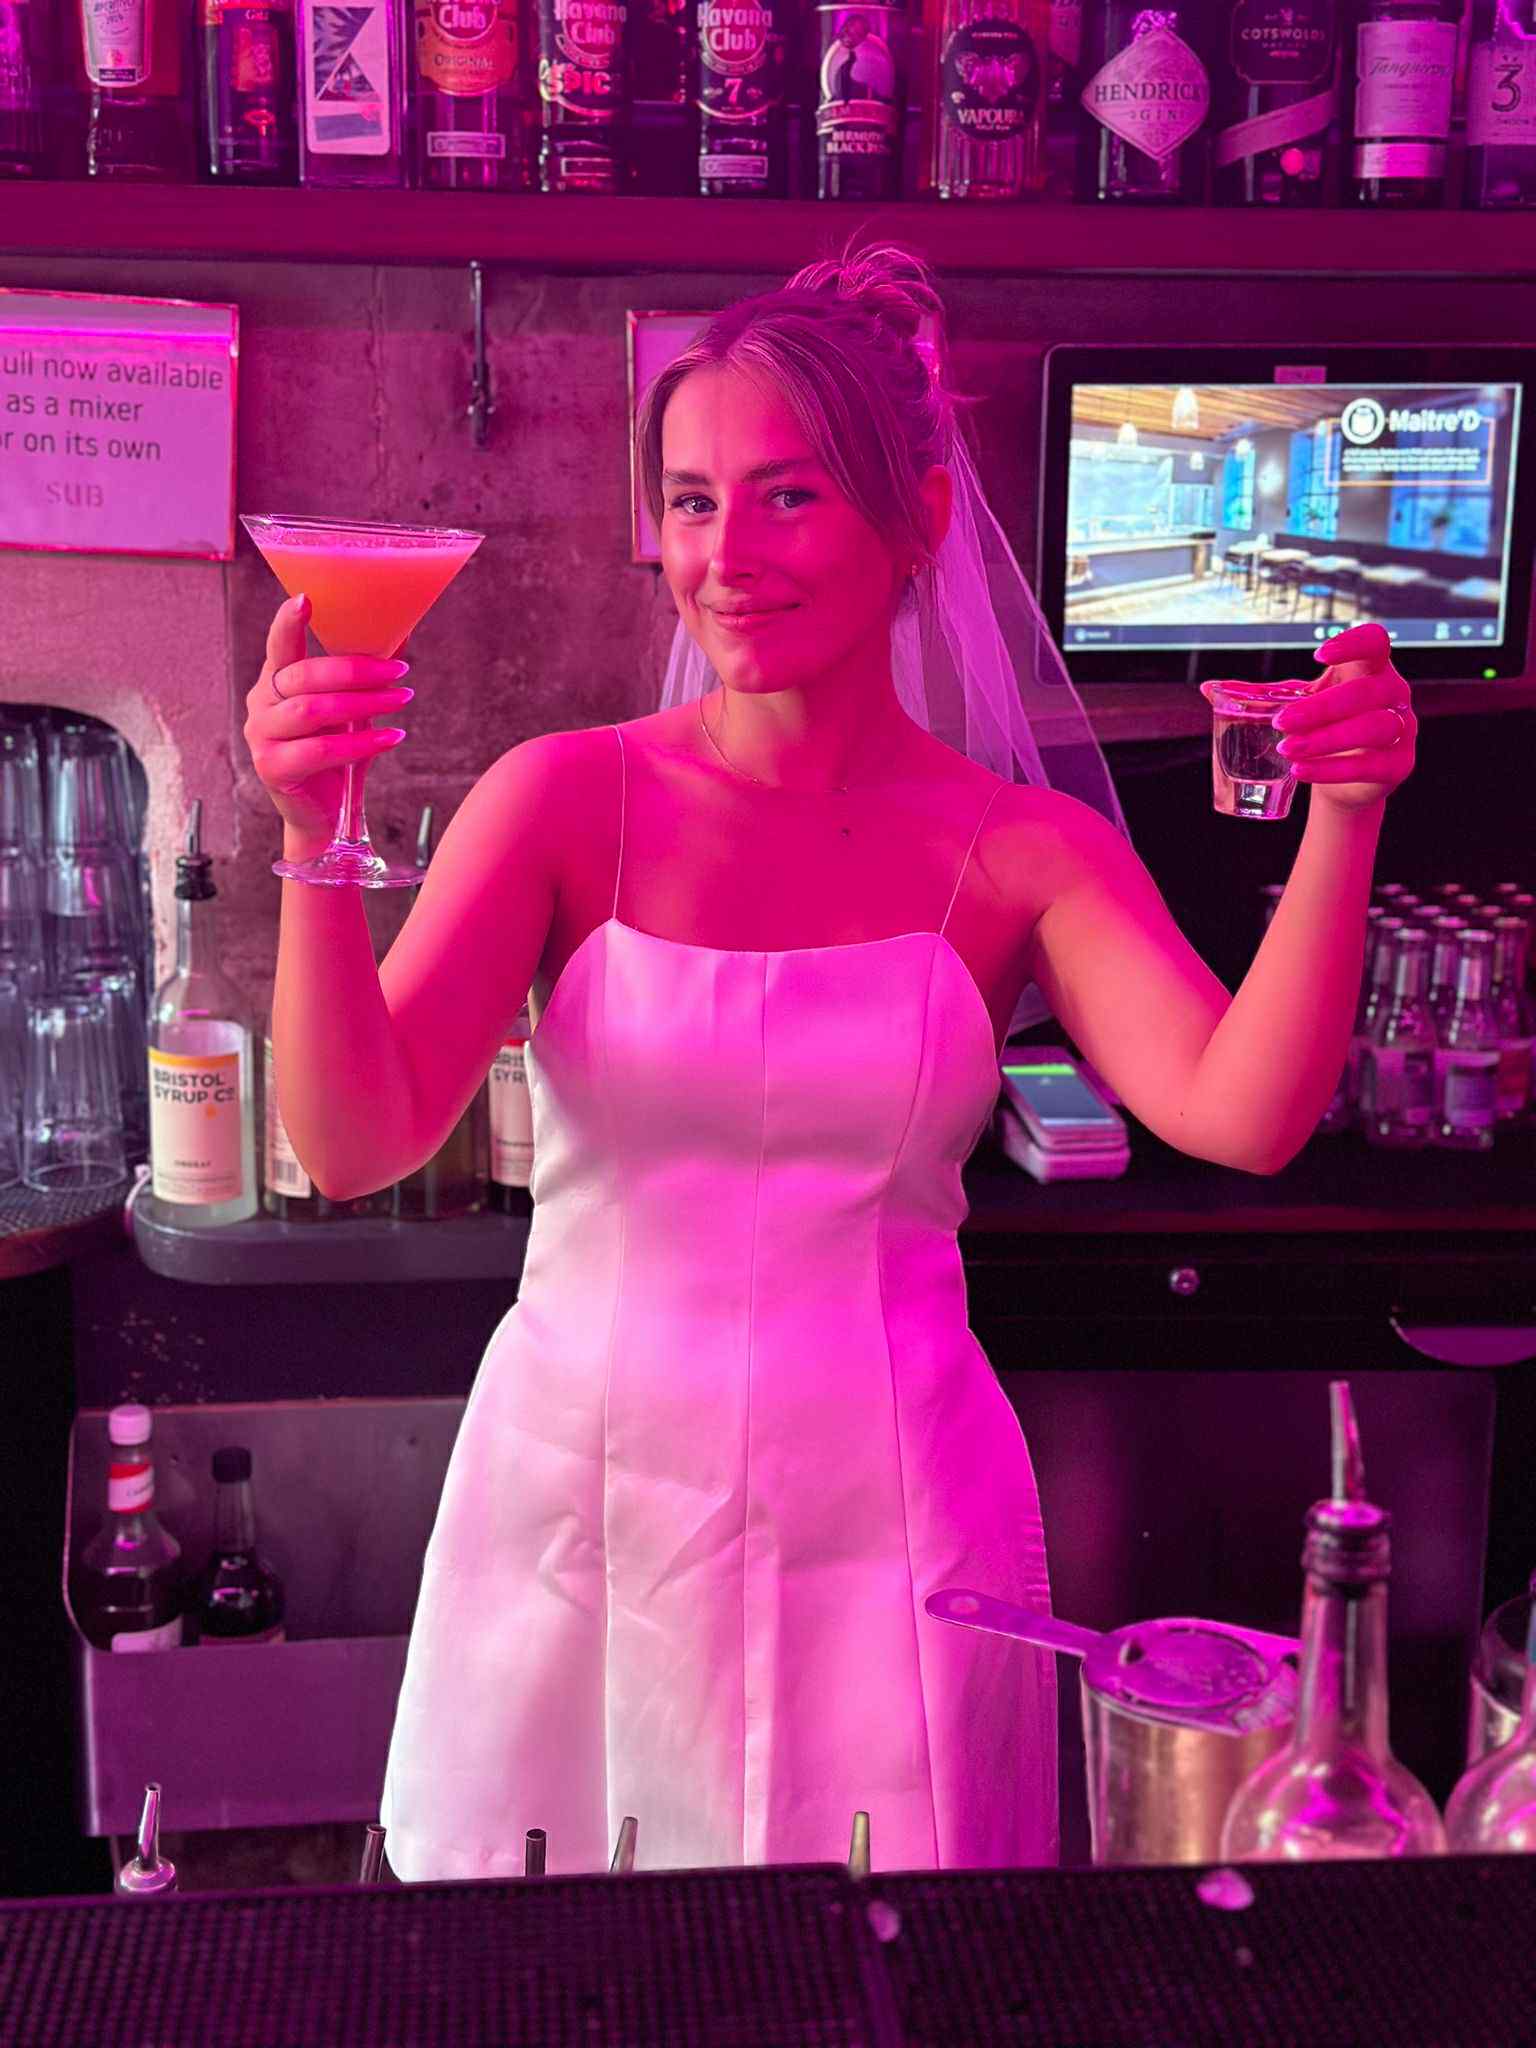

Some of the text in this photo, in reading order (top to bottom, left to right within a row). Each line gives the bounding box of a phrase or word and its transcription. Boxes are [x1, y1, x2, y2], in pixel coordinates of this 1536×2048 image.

[439, 4, 487, 29] Club
[697, 1, 773, 28] Havana
[570, 21, 615, 45] Club
[710, 27, 757, 52] Club
[724, 78, 743, 105] 7
[1490, 64, 1523, 113] 3
[1140, 109, 1178, 121] GIN
[0, 350, 224, 391] ull now available
[6, 393, 144, 423] as a mixer
[0, 430, 162, 461] r on its own
[47, 481, 104, 508] SUB
[153, 1067, 226, 1089] BRISTOL
[154, 1084, 209, 1104] SYRUP
